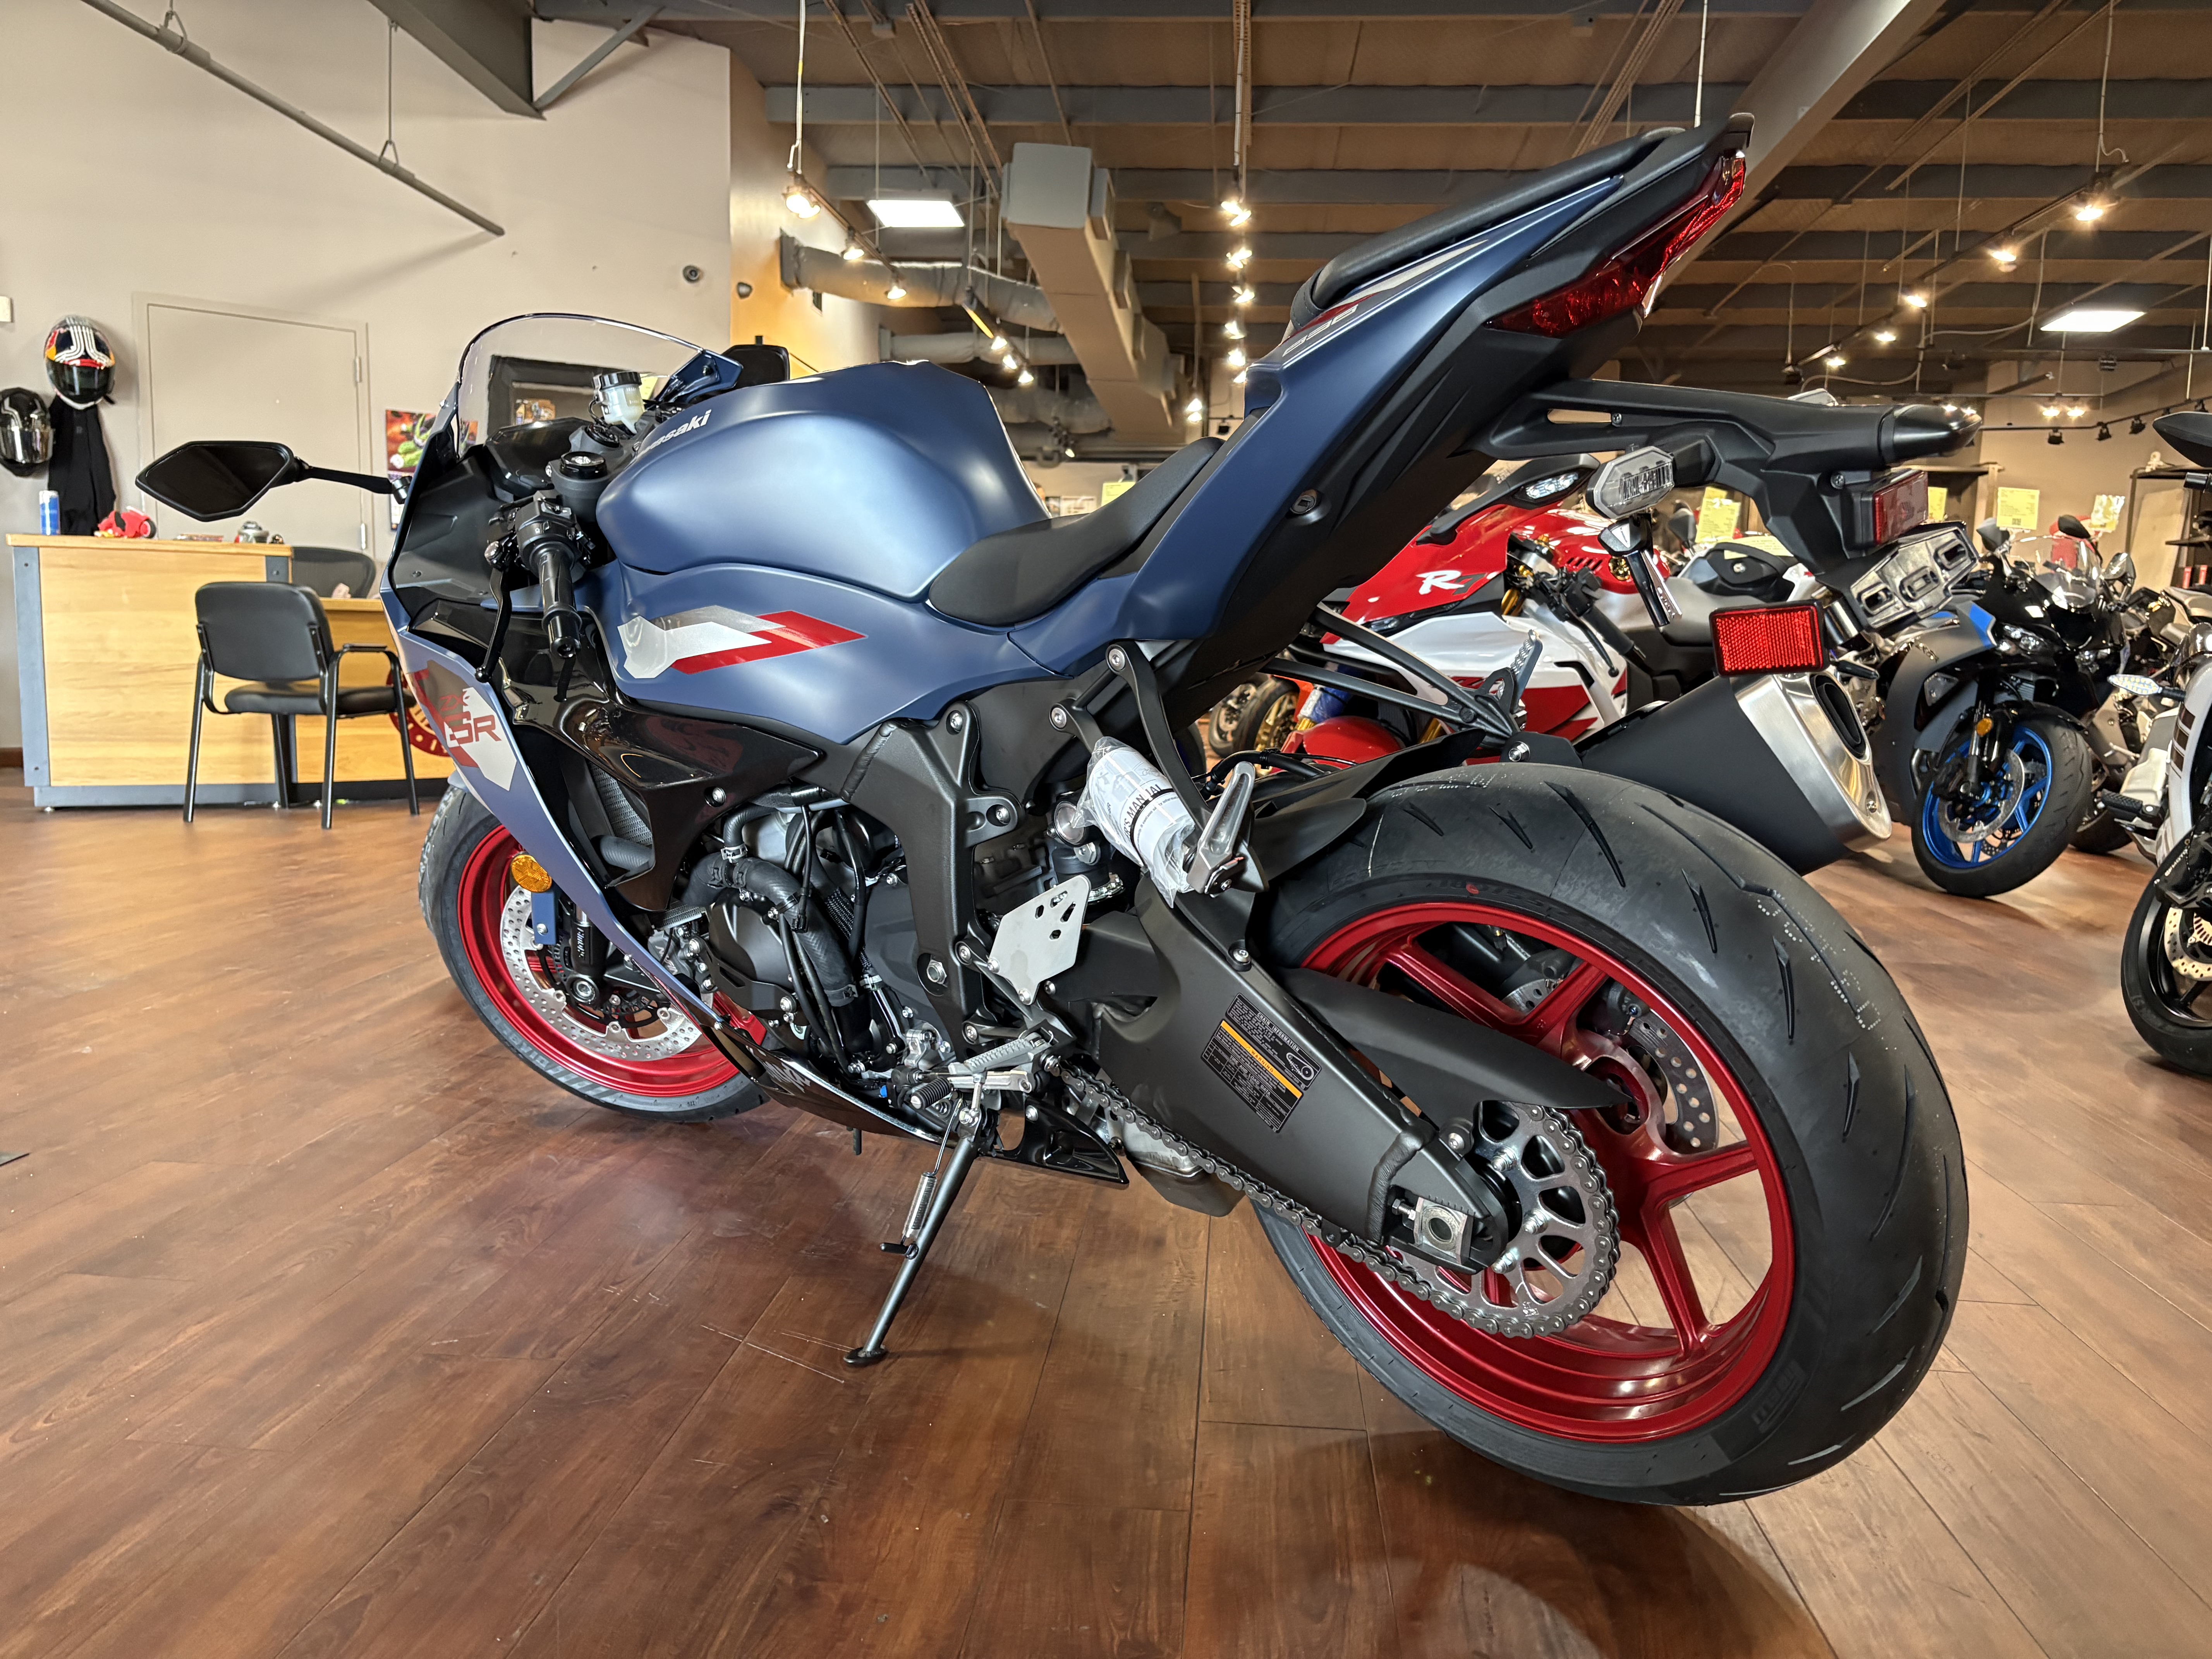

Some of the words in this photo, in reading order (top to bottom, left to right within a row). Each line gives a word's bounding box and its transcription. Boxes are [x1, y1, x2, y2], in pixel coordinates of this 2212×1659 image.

[1415, 570, 1487, 596] R7
[1257, 1012, 1271, 1026] CHAIN
[1272, 1025, 1300, 1052] INFORMATION
[1230, 1054, 1239, 1065] TIRE
[1239, 1065, 1248, 1073] AND
[1248, 1073, 1260, 1085] LOAD
[1260, 1083, 1271, 1096] DATA
[1251, 1050, 1274, 1073] WARNING
